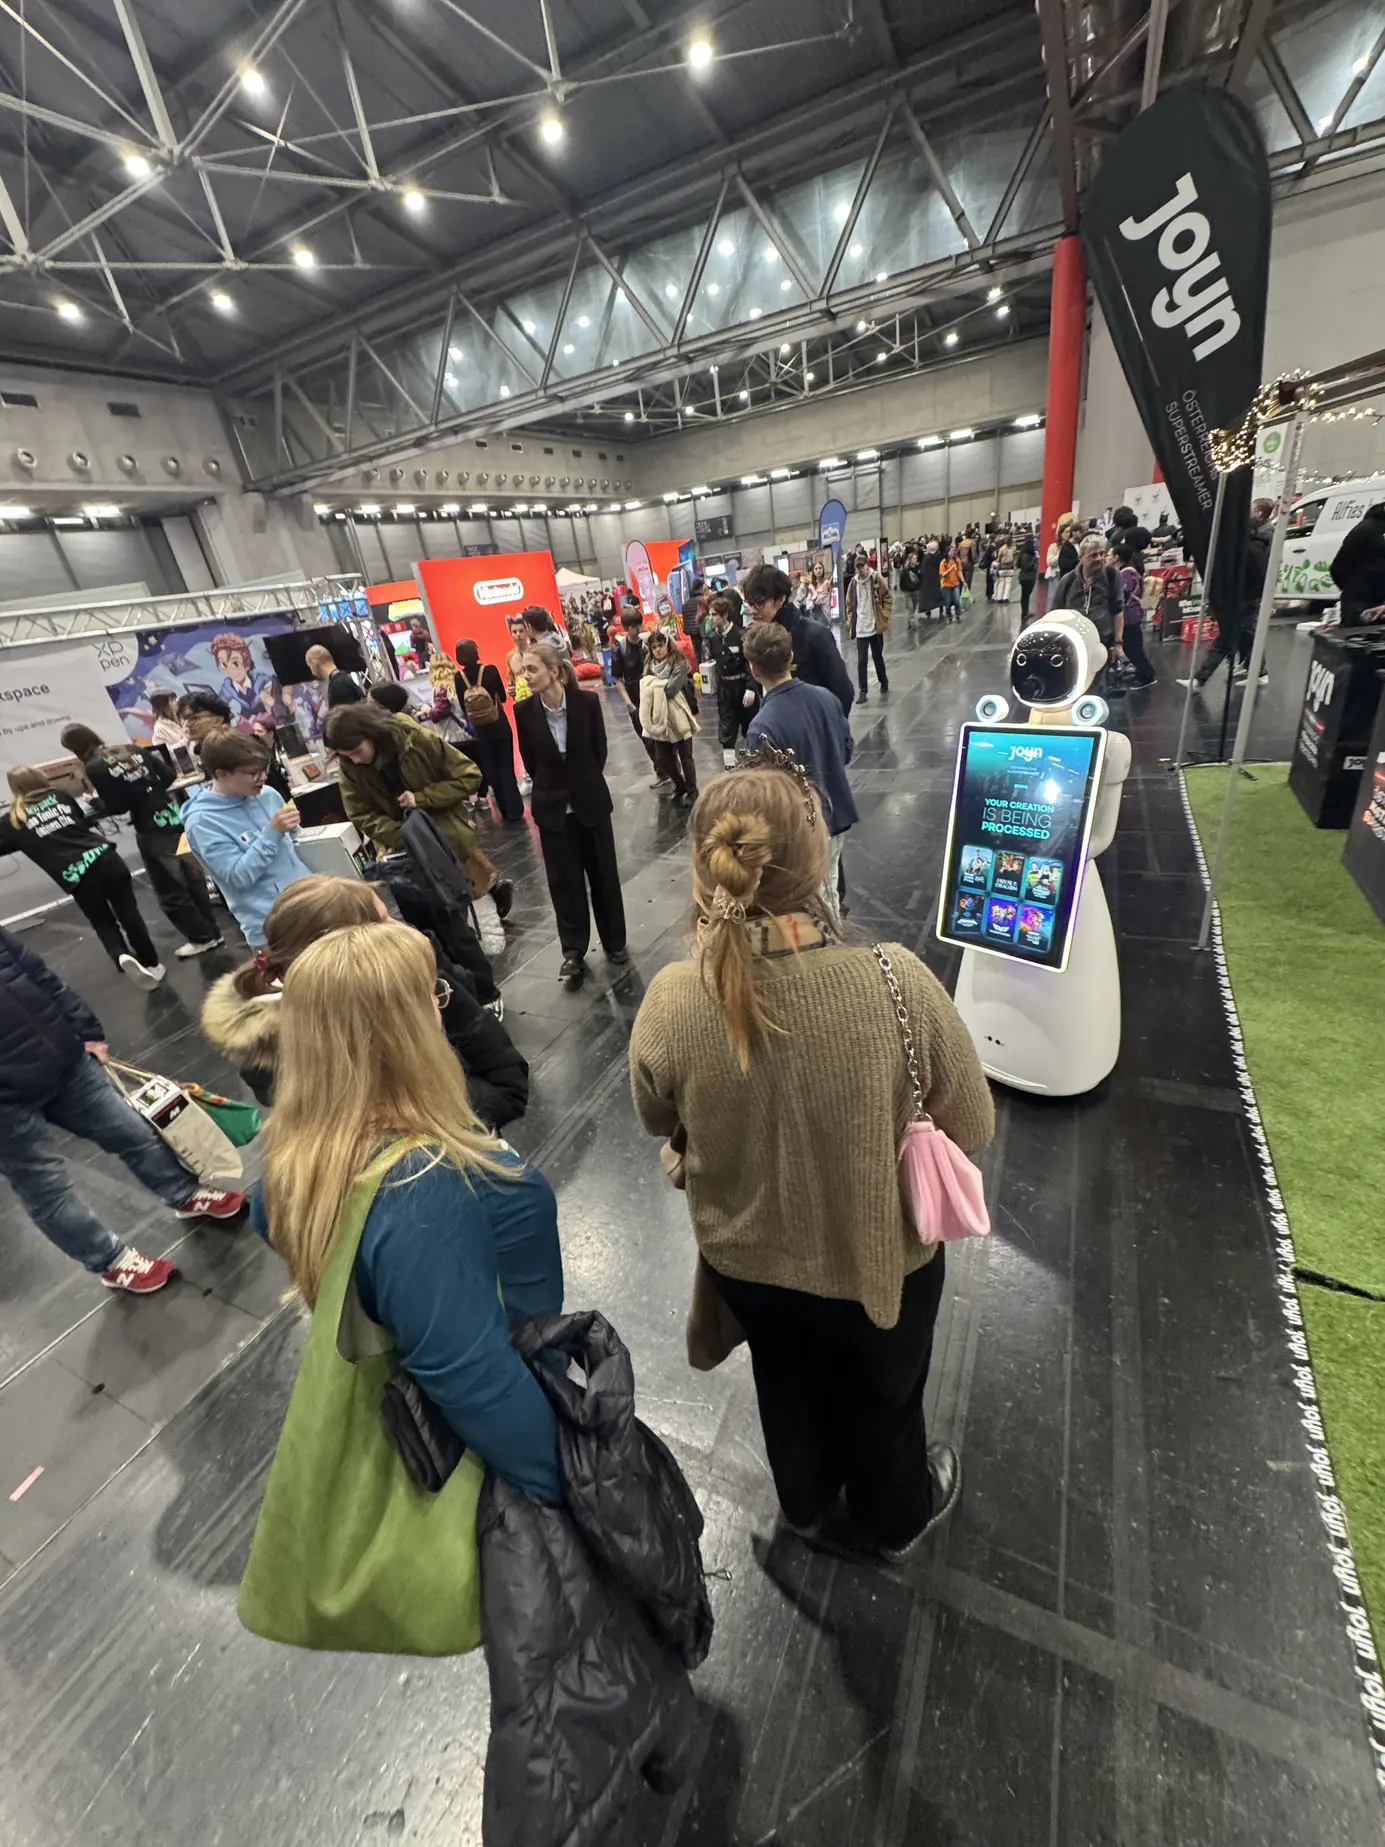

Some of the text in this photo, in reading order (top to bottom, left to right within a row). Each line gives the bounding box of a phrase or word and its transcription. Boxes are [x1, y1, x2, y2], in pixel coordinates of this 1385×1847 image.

[1165, 401, 1213, 510] SUPERSTREAMER
[1331, 500, 1365, 520] Alfies
[100, 655, 130, 672] pen
[984, 798, 1054, 814] YOUR CREATION
[982, 807, 1052, 829] IS BEING
[981, 821, 1050, 840] PROCESSED
